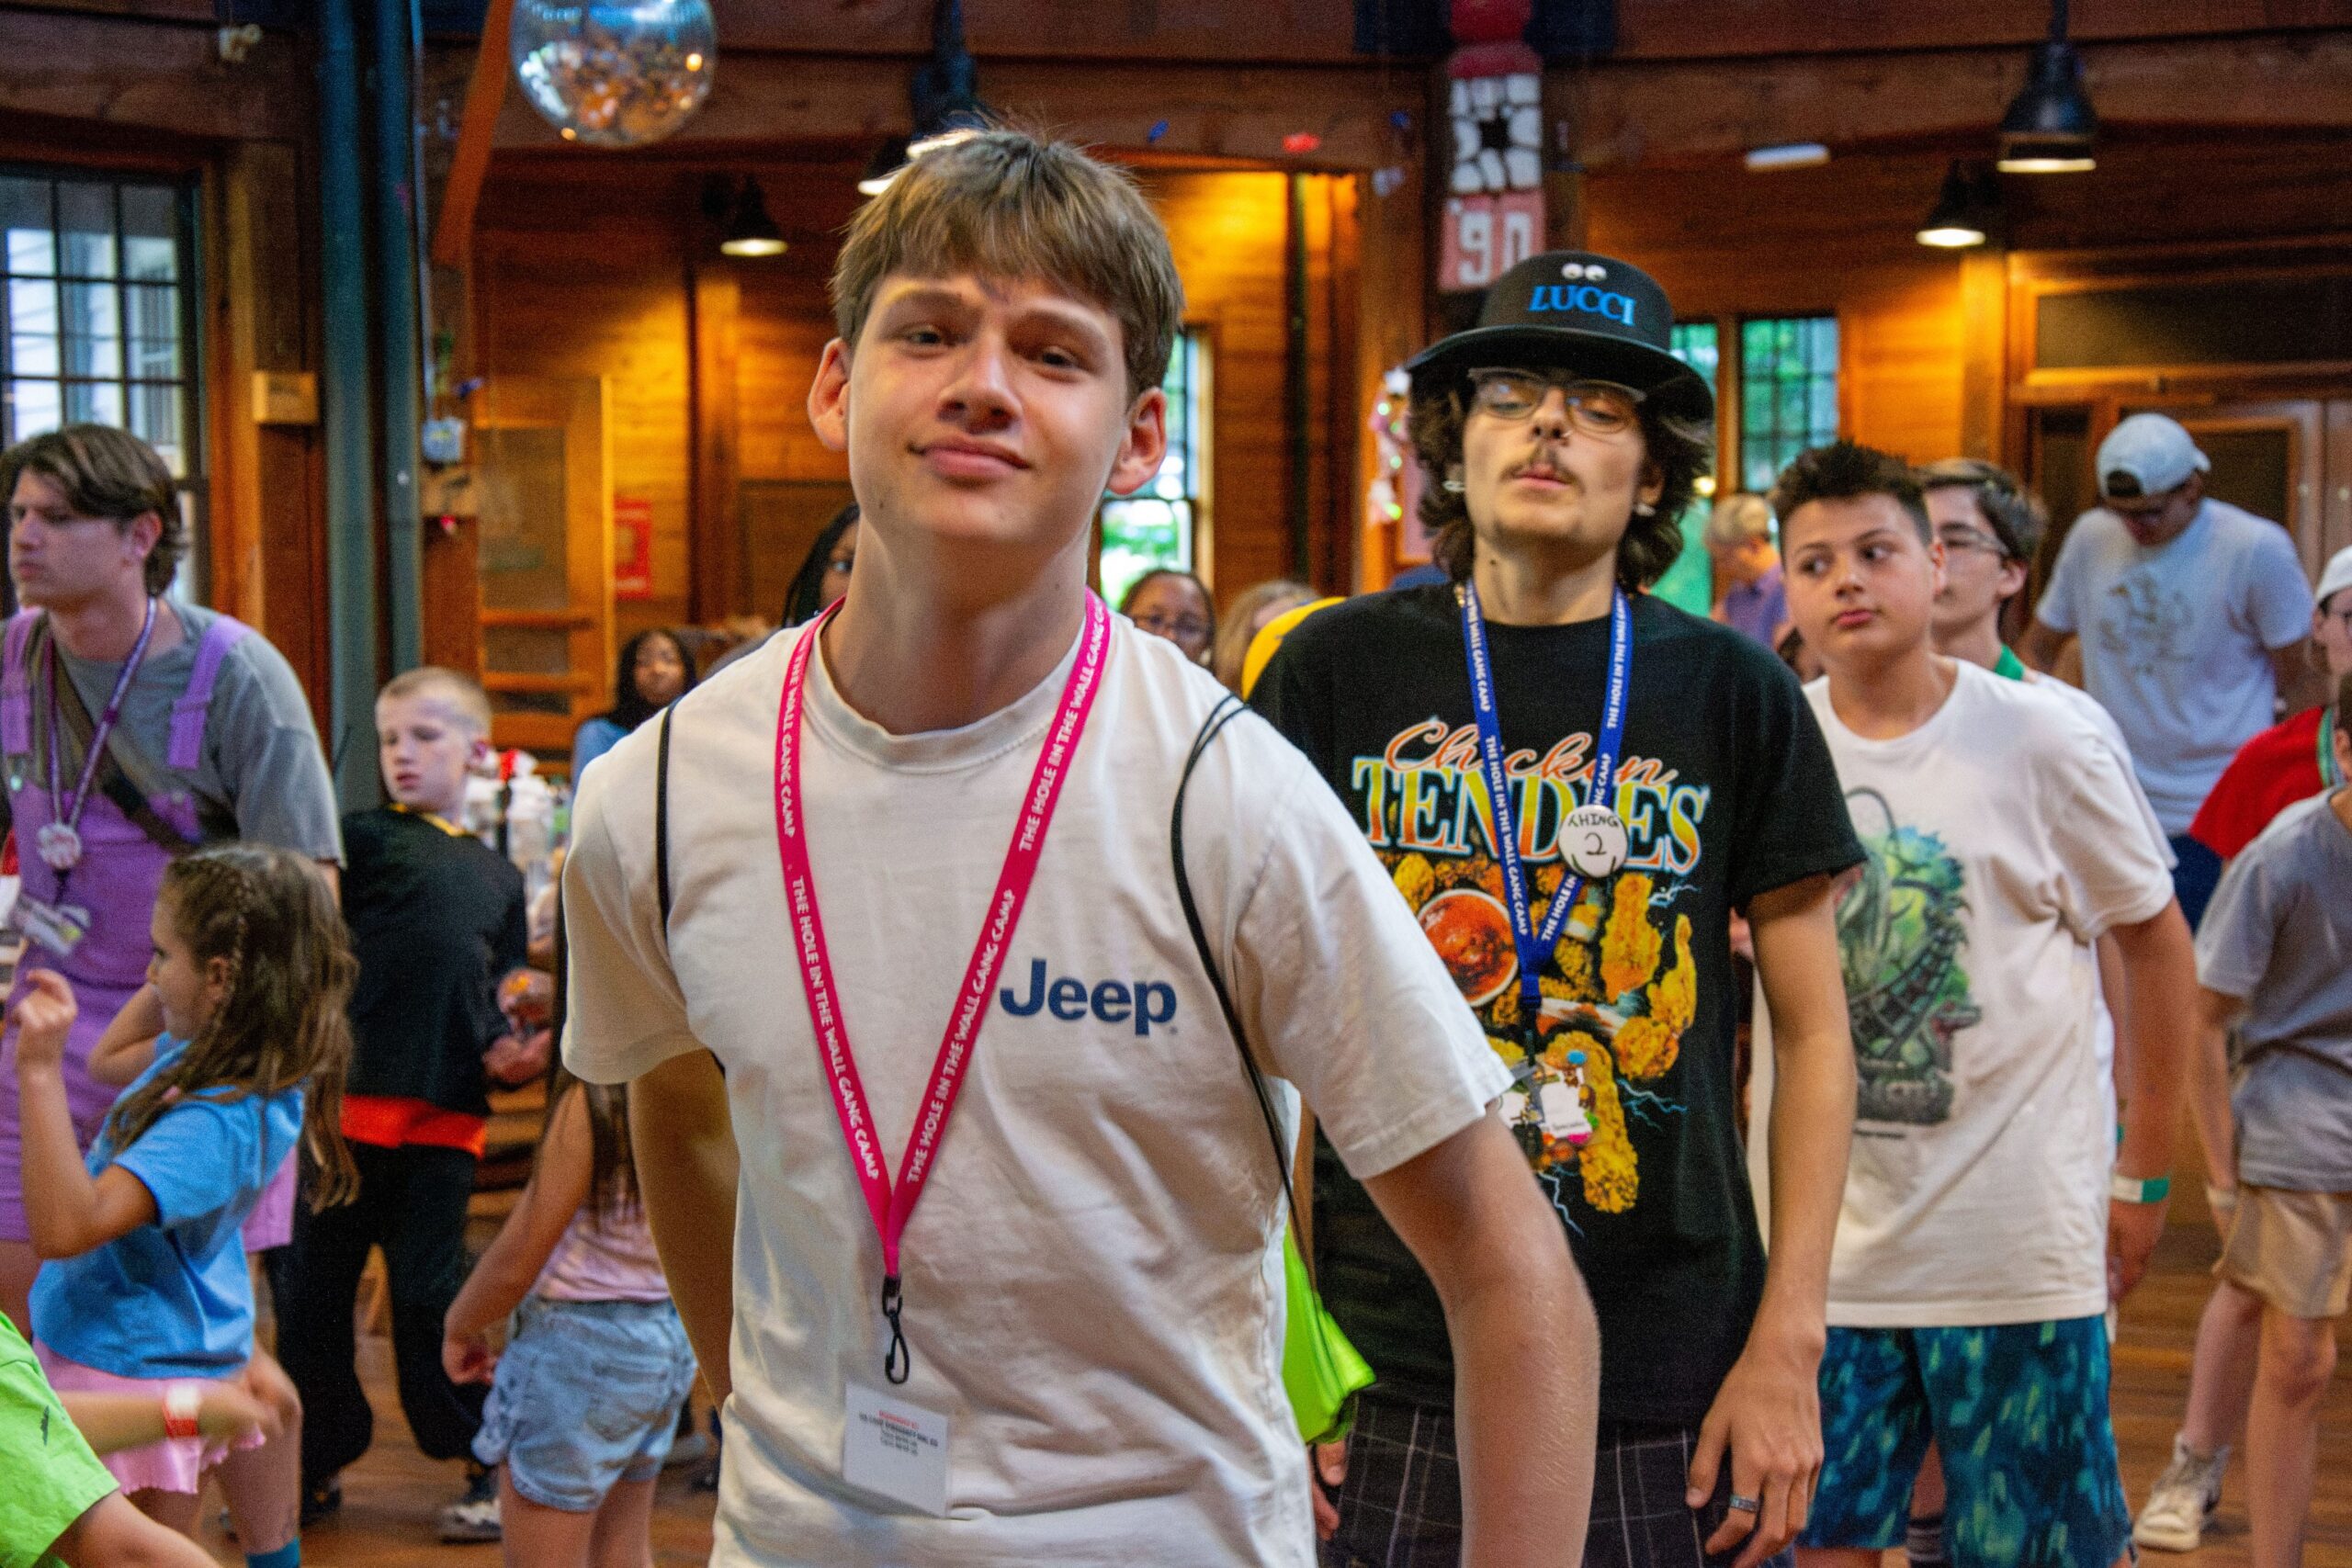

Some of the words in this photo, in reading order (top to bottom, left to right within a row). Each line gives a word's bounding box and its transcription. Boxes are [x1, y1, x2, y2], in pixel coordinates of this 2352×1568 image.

[1528, 284, 1636, 326] LUCCI
[1470, 622, 1482, 649] WALL
[1616, 619, 1626, 643] WALL
[1472, 649, 1487, 680] GANG
[1613, 662, 1624, 678] IN
[1614, 642, 1626, 663] THE
[1477, 680, 1491, 712] CAMP
[1610, 678, 1623, 706] HOLE
[783, 687, 797, 733] WALL
[1606, 706, 1620, 729] THE
[1019, 815, 1040, 852] THE
[1031, 765, 1057, 816] HOLE
[1047, 742, 1066, 767] IN
[1057, 708, 1079, 743] THE
[1069, 666, 1095, 708] WALL
[1086, 622, 1104, 667] GANG
[1385, 720, 1679, 785] Chckn
[1485, 735, 1498, 761] THE
[781, 734, 793, 783] GANG
[1598, 752, 1611, 786] CAMP
[1489, 761, 1504, 792] HOLE
[781, 785, 796, 838] CAMP
[1352, 756, 1711, 874] TENDES
[1495, 793, 1507, 808] IN
[1498, 808, 1511, 832] THE
[1567, 813, 1619, 829] THING
[1503, 831, 1516, 866] WALL
[1585, 831, 1608, 856] 2
[793, 875, 809, 915] THE
[1509, 866, 1522, 900] GANG
[1514, 901, 1528, 936] CAMP
[1541, 918, 1558, 941] THE
[1551, 887, 1571, 919] HOLE
[799, 915, 820, 964] HOLE
[809, 965, 825, 989] IN
[815, 988, 834, 1027] THE
[999, 957, 1177, 1036] Jeep
[825, 1026, 847, 1077] WALL
[906, 1147, 929, 1183] THE
[919, 1100, 944, 1148] HOLE
[934, 1077, 952, 1100] IN
[943, 1041, 965, 1077] THE
[954, 995, 980, 1041] WALL
[972, 942, 999, 995] GANG
[991, 888, 1015, 942] CAMP
[838, 1077, 864, 1129] GANG
[854, 1128, 880, 1180] CAMP
